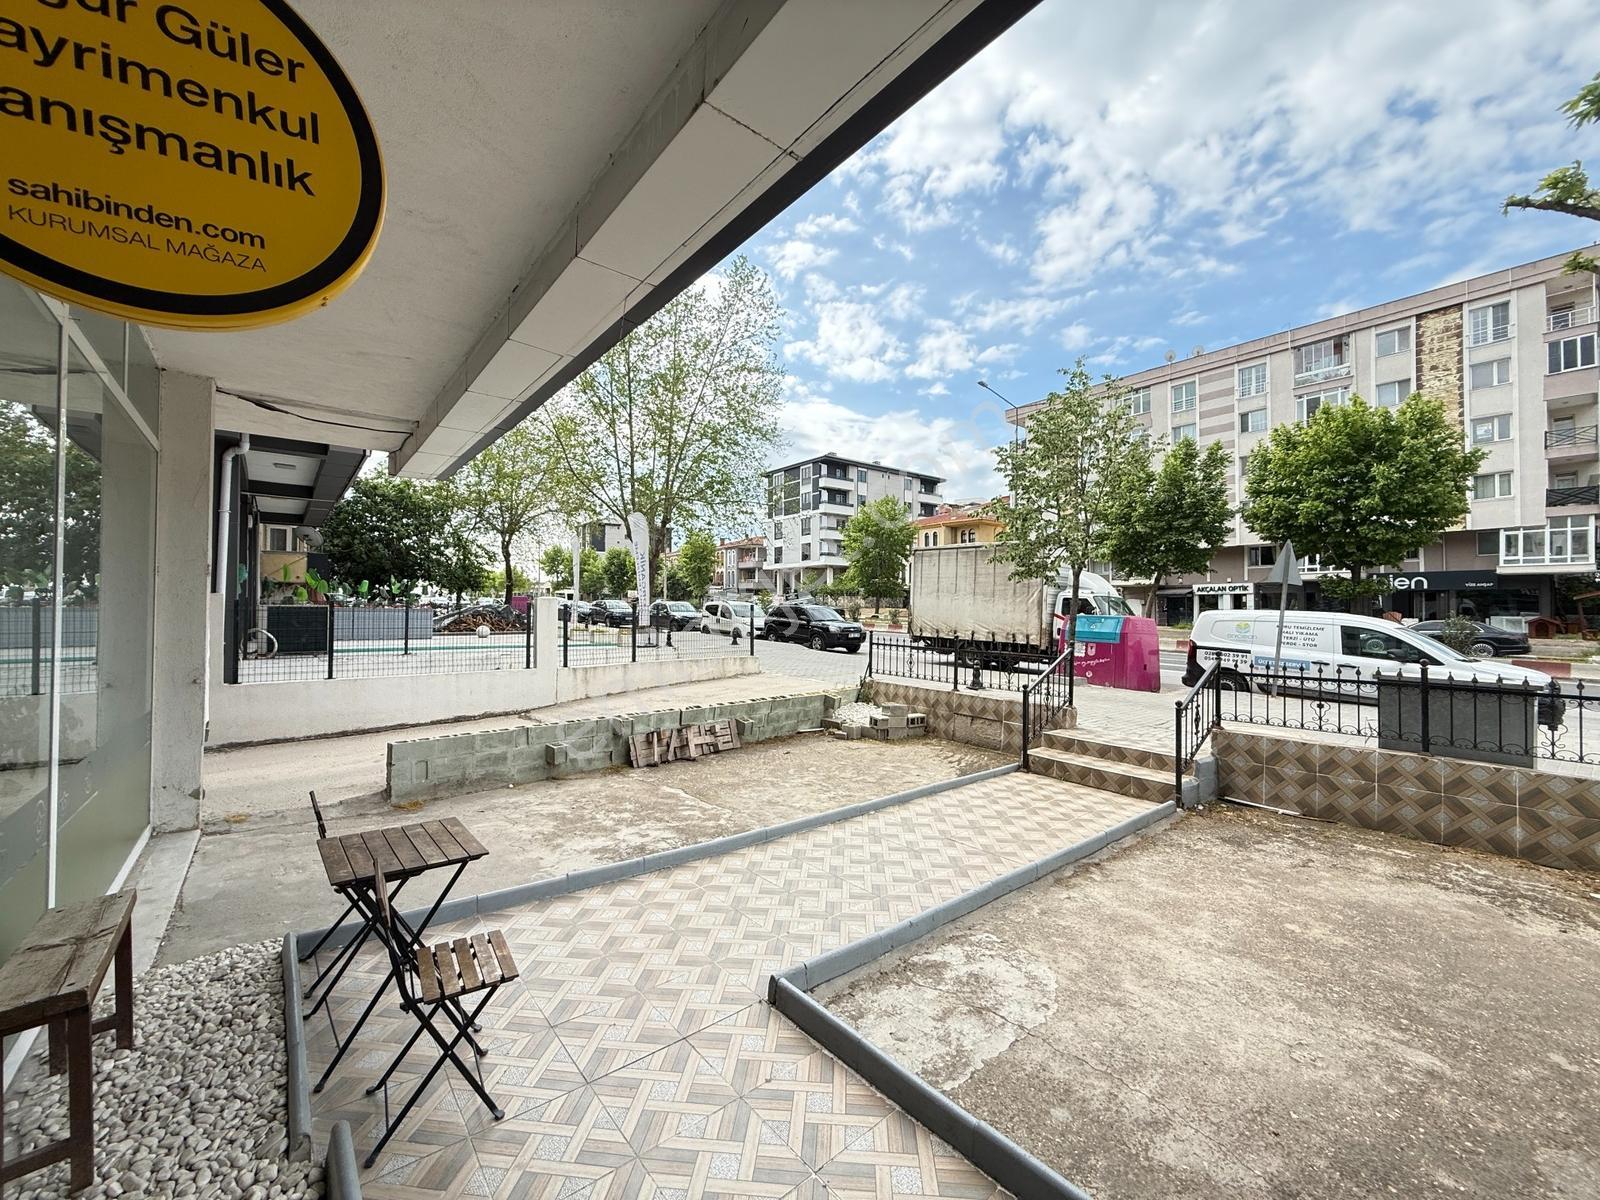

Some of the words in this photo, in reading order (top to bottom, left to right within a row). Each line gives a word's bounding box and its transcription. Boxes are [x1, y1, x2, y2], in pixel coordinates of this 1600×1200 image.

[155, 4, 305, 84] Güler
[7, 177, 266, 250] sahibinden.com
[7, 204, 161, 251] KURUMSAL
[165, 237, 268, 273] MAĞAZA
[1372, 574, 1428, 589] ien
